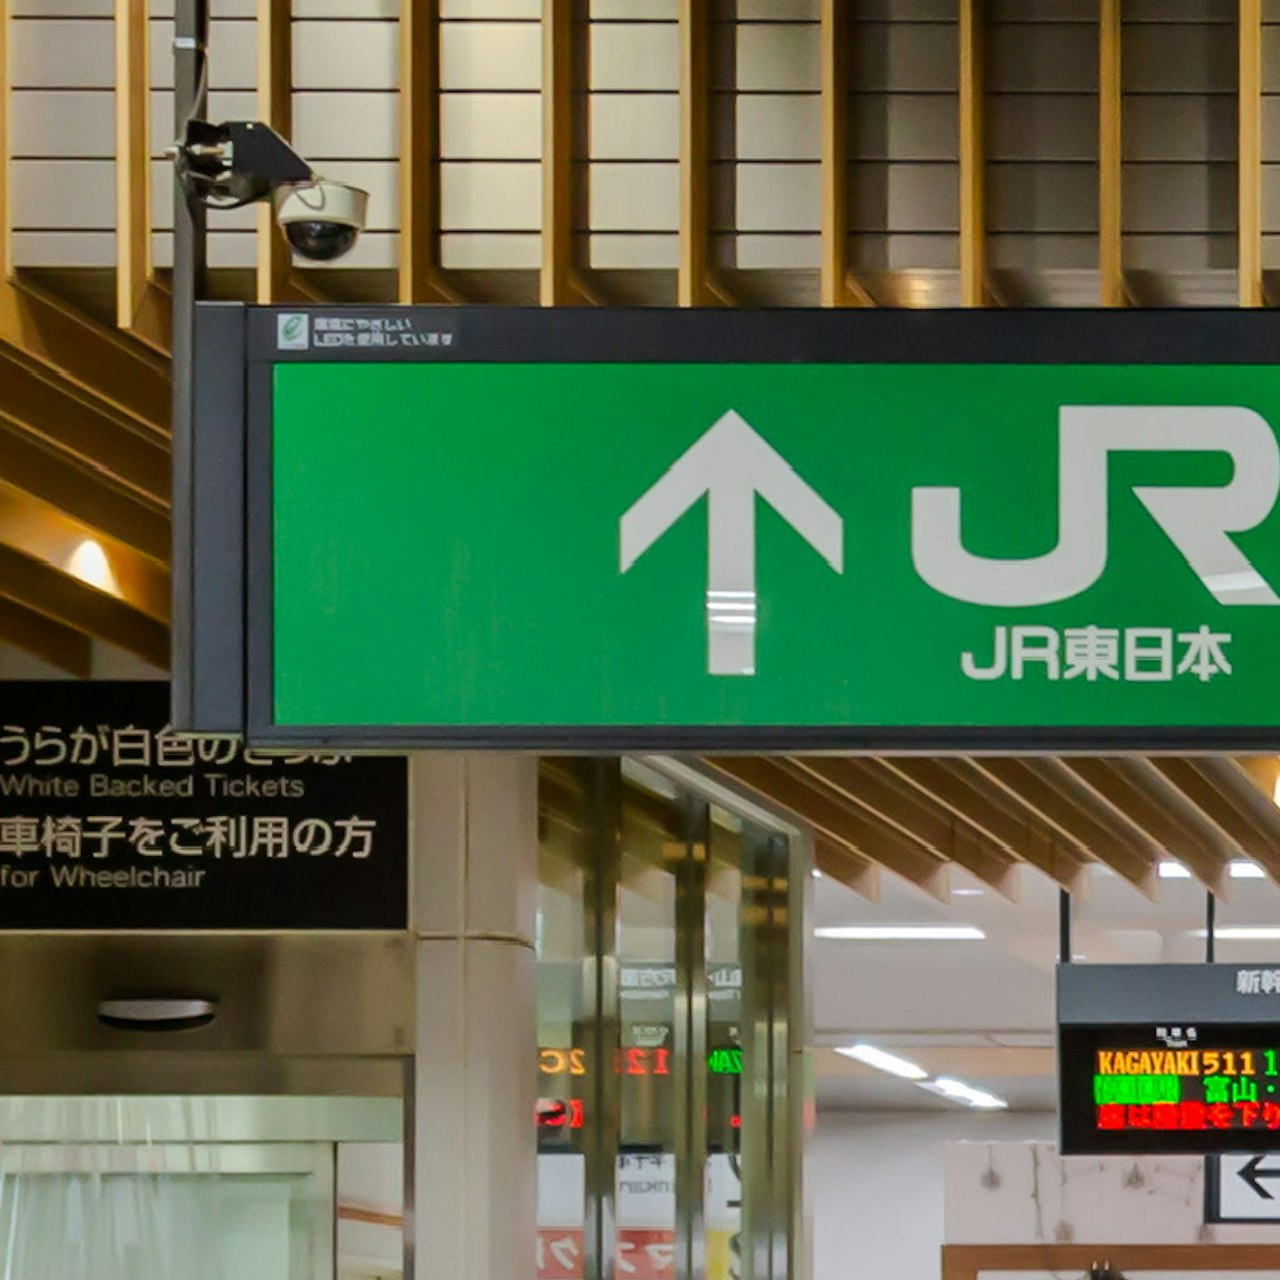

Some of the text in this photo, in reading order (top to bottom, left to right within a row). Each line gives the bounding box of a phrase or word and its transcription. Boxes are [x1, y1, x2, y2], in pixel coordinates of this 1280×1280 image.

[961, 625, 1232, 683] JR東日本
[0, 773, 305, 797] White Backed Tickets
[0, 815, 377, 858] 車椅子をご利用の方
[0, 864, 206, 888] for Wheelchair
[1098, 1050, 1200, 1075] KAGAYAKI
[1203, 1050, 1256, 1076] 511
